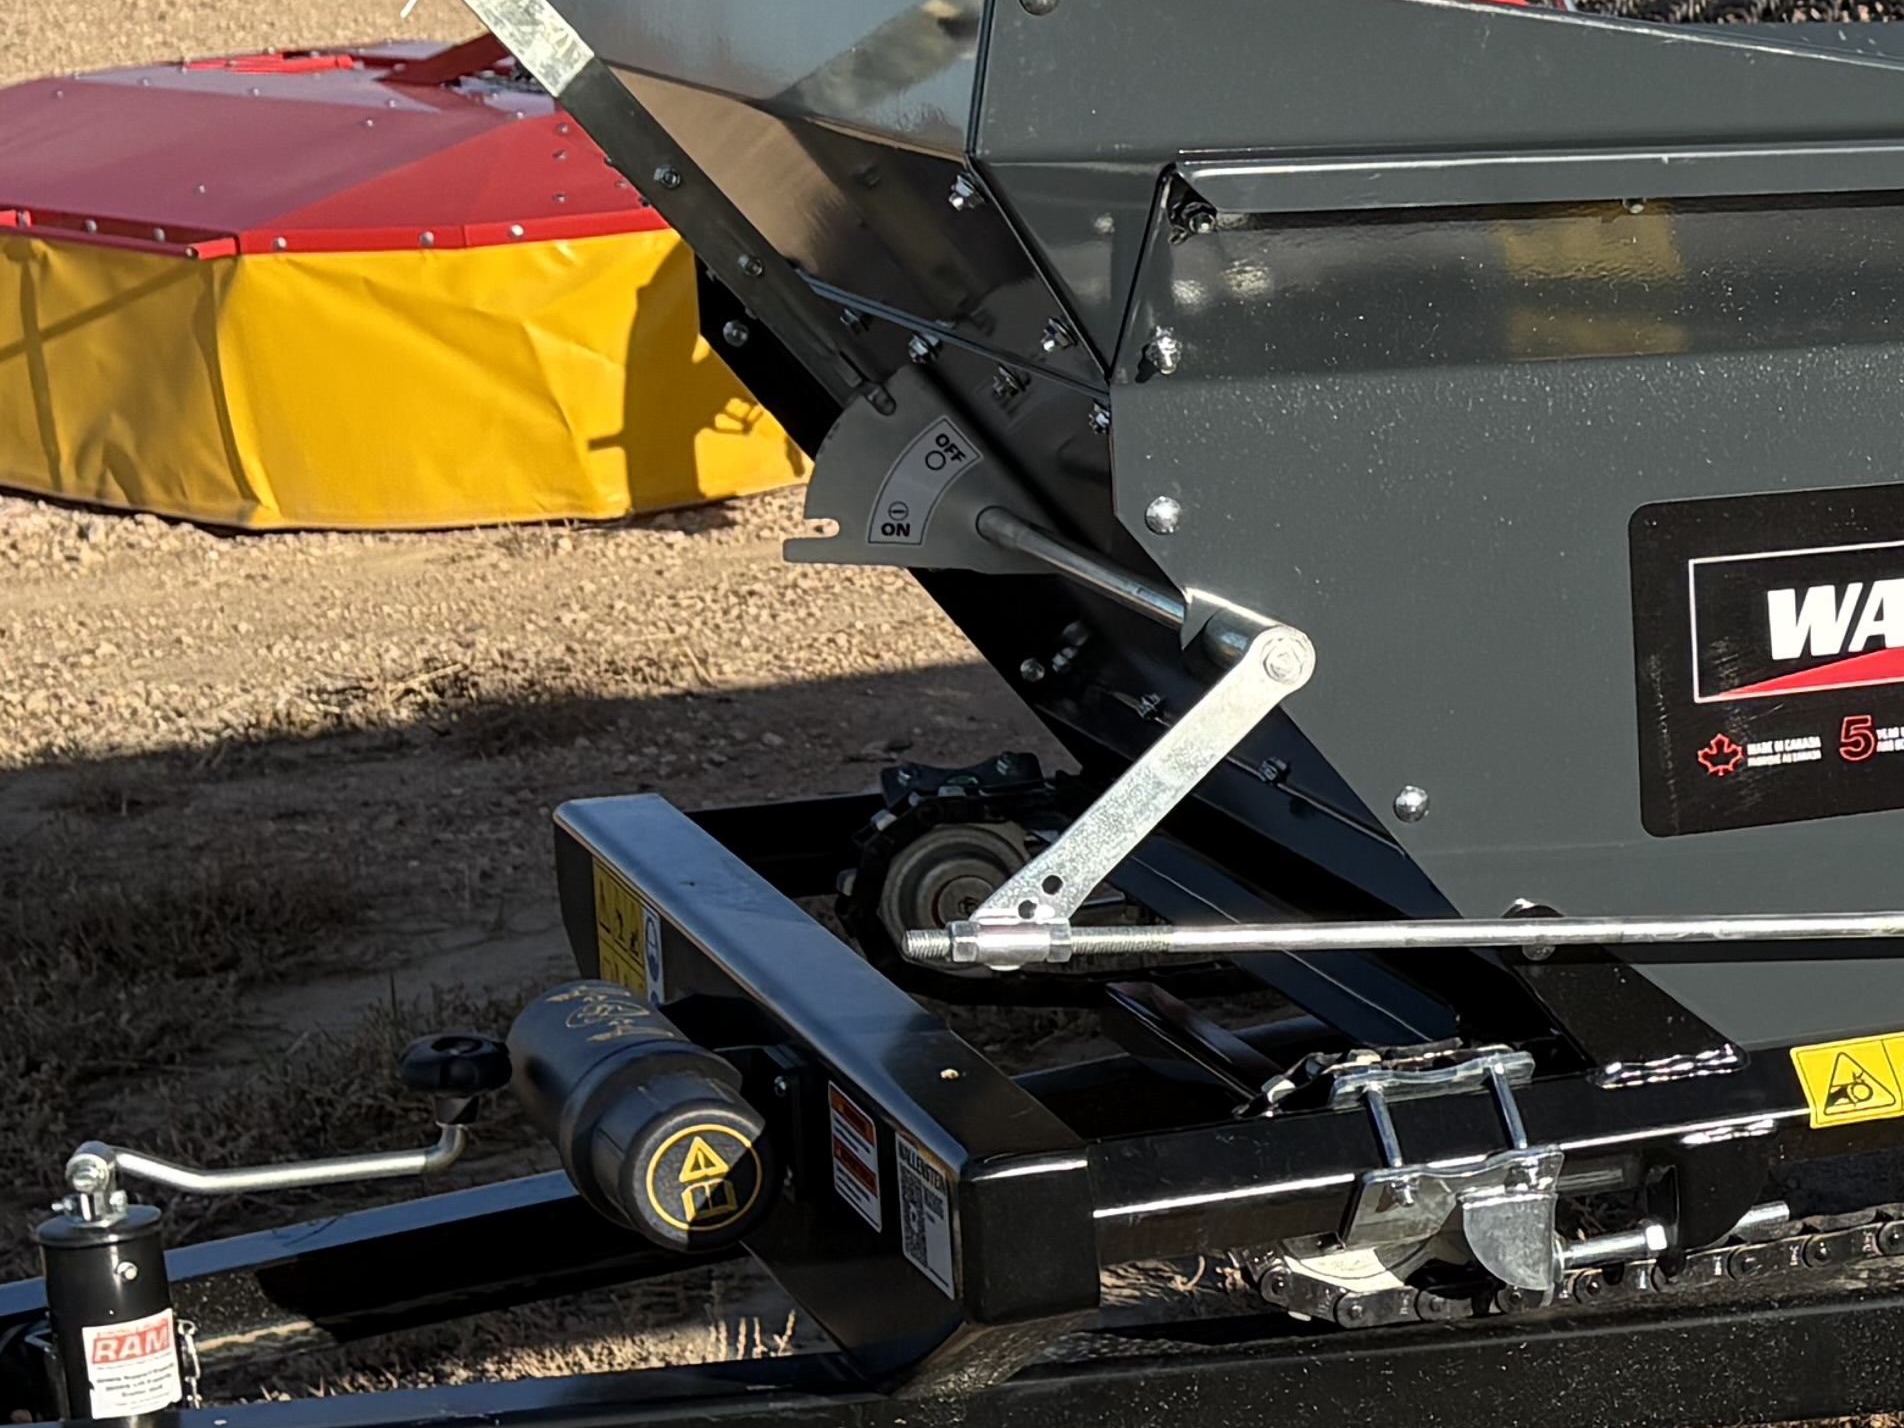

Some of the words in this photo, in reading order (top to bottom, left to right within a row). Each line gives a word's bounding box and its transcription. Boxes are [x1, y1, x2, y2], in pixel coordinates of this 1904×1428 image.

[935, 433, 967, 462] OFF
[881, 522, 911, 537] ON
[1839, 714, 1875, 761] 5
[94, 1325, 169, 1361] RAM
